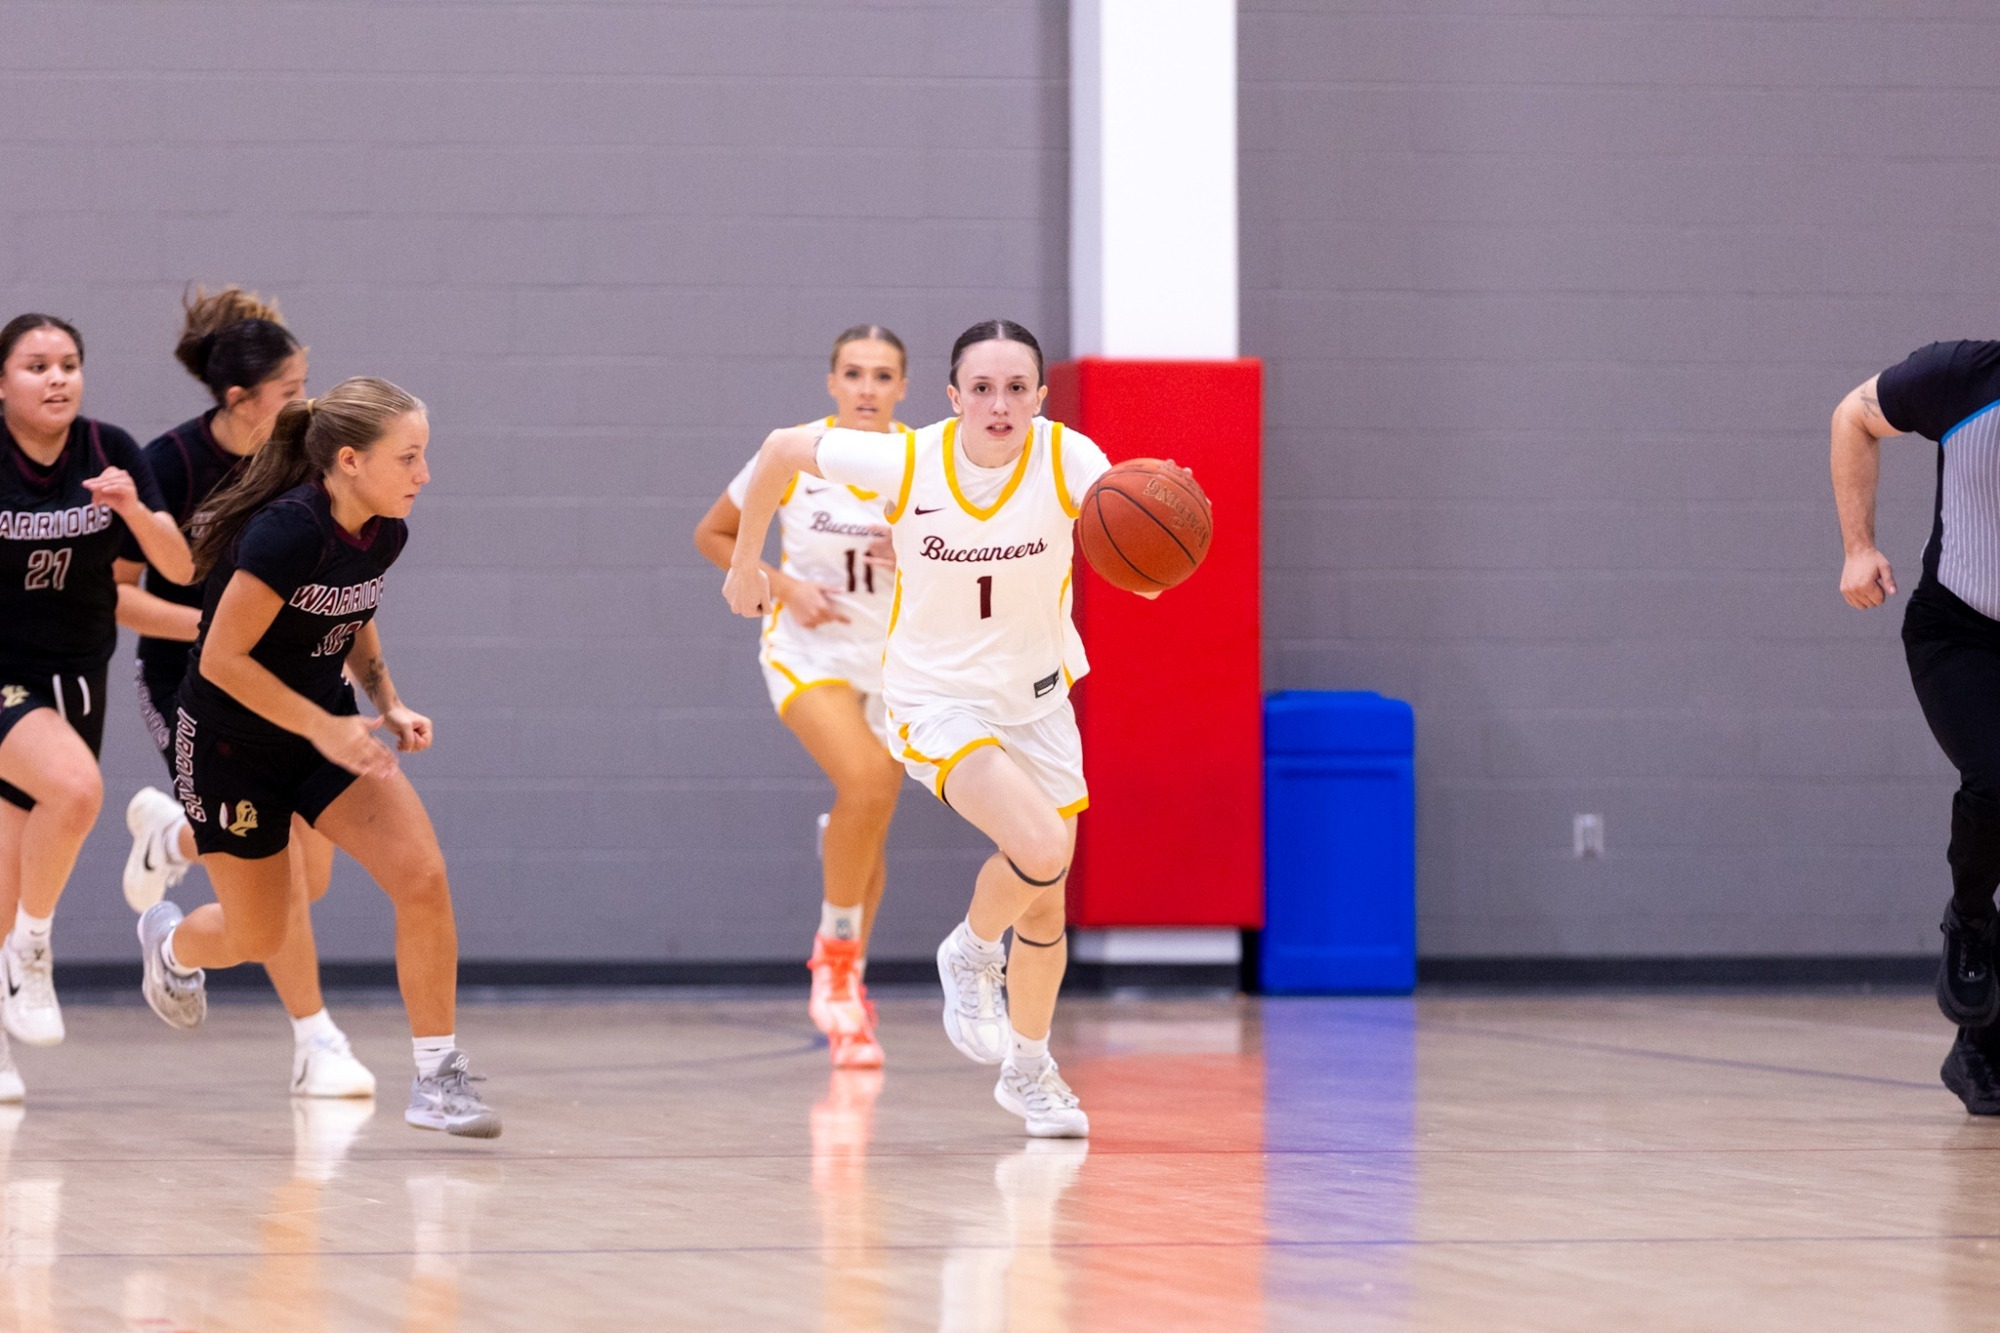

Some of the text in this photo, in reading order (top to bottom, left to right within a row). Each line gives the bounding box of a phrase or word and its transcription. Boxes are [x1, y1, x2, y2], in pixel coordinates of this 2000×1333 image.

[0, 503, 112, 540] ARRIORS
[24, 547, 73, 591] 21
[919, 535, 1048, 563] Buccaneers
[976, 575, 993, 620] 1
